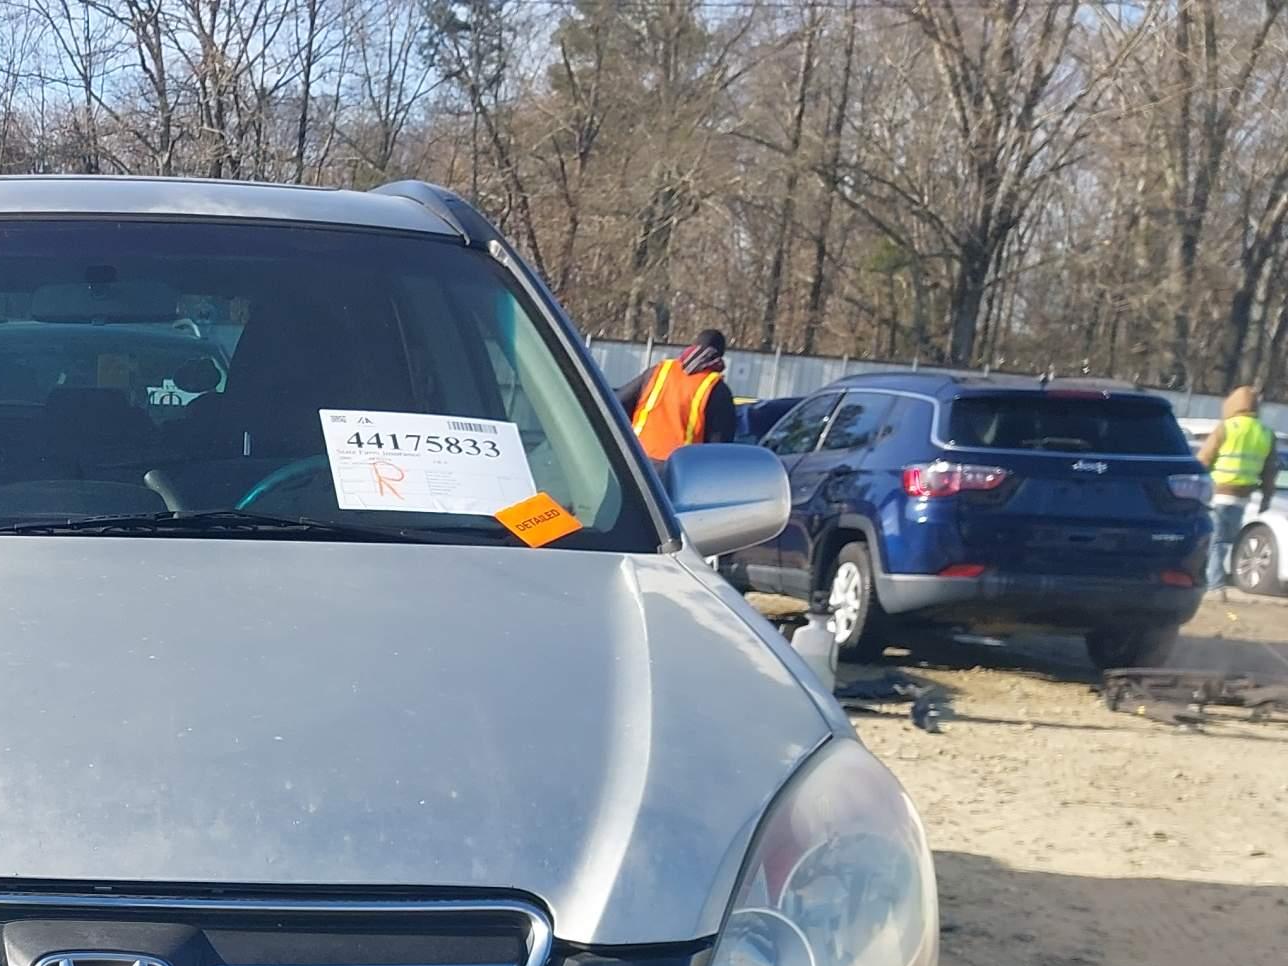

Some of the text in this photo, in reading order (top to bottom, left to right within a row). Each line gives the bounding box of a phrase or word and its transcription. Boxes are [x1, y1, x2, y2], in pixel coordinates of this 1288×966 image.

[346, 431, 501, 458] 44175833
[370, 461, 405, 500] R
[515, 508, 561, 532] DETAILED
